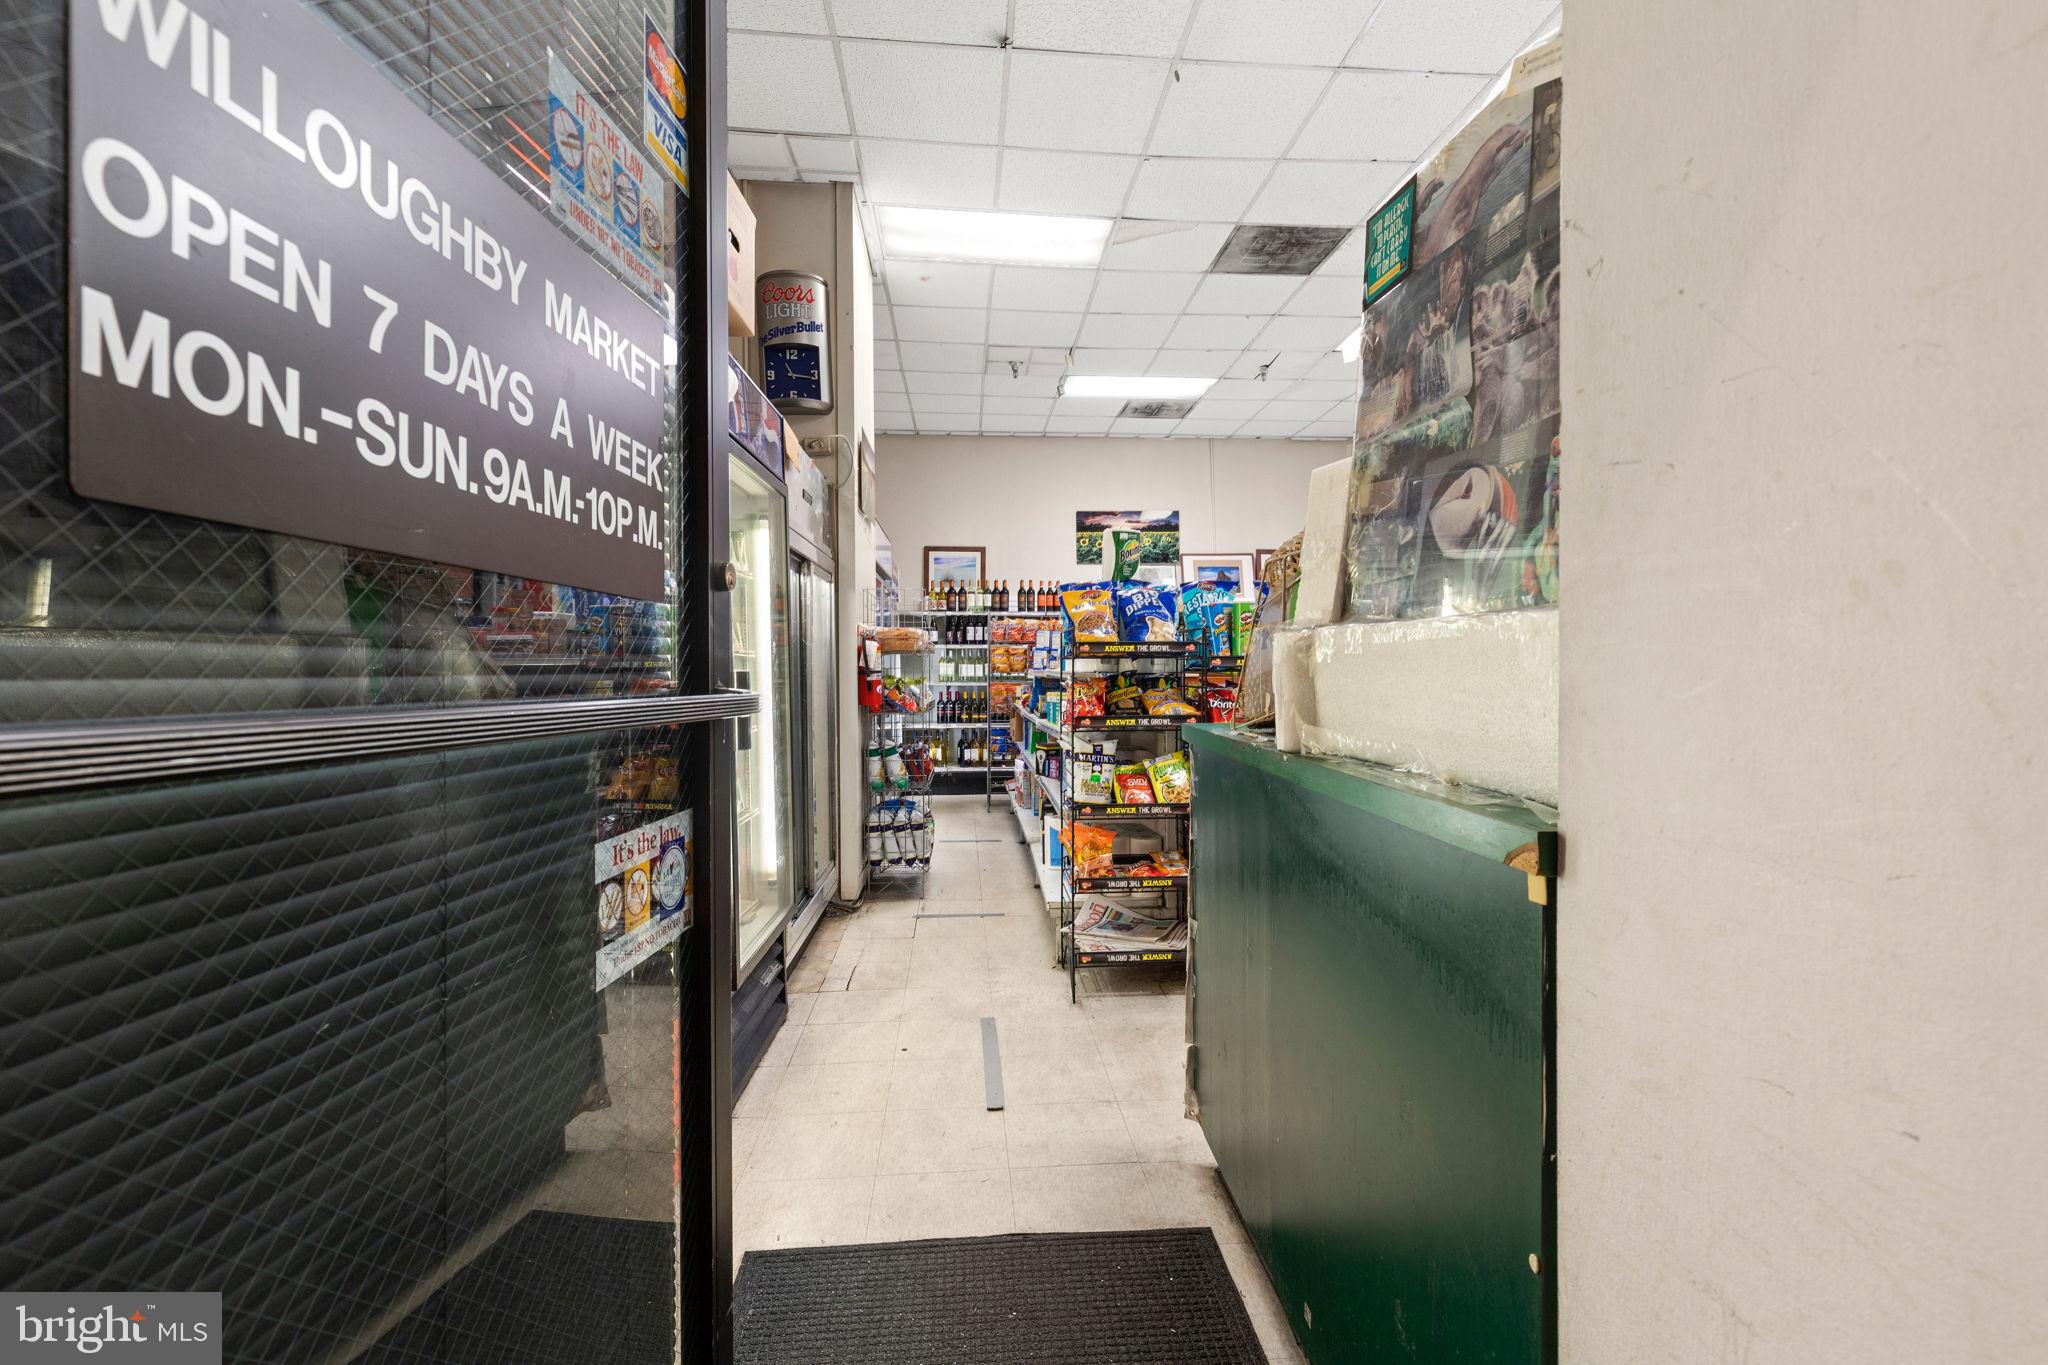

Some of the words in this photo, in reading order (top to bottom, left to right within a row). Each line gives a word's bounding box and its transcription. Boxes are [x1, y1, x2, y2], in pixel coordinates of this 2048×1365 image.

[654, 115, 683, 168] VISA
[600, 118, 621, 161] THE
[624, 145, 644, 181] LAW
[97, 0, 528, 304] WILLOUGHBY
[544, 279, 660, 398] MARKET
[761, 282, 815, 304] Coors
[81, 136, 331, 328] OPEN
[362, 285, 399, 354] 7
[424, 320, 533, 426] DAYS
[550, 397, 574, 449] A
[588, 414, 664, 493] WEEK
[766, 303, 812, 319] LIGHT
[768, 325, 797, 339] Silver
[796, 321, 823, 333] Bullet
[785, 350, 798, 360] 12
[767, 371, 775, 380] 9
[811, 370, 818, 380] 3
[1132, 590, 1159, 604] BIG
[1125, 597, 1163, 617] DIPPE
[1110, 684, 1138, 700] Smartfood
[1209, 699, 1238, 708] Dorit
[1151, 718, 1172, 726] GROWL
[1079, 754, 1115, 763] MARTIN'S
[612, 837, 634, 867] It's
[637, 830, 656, 856] the
[1107, 880, 1128, 888] GROWL
[1128, 880, 1141, 888] THE
[1142, 879, 1173, 887] ANSWER
[1107, 954, 1128, 962] GROWL
[1128, 954, 1141, 962] THE
[1142, 953, 1173, 961] ANSWER
